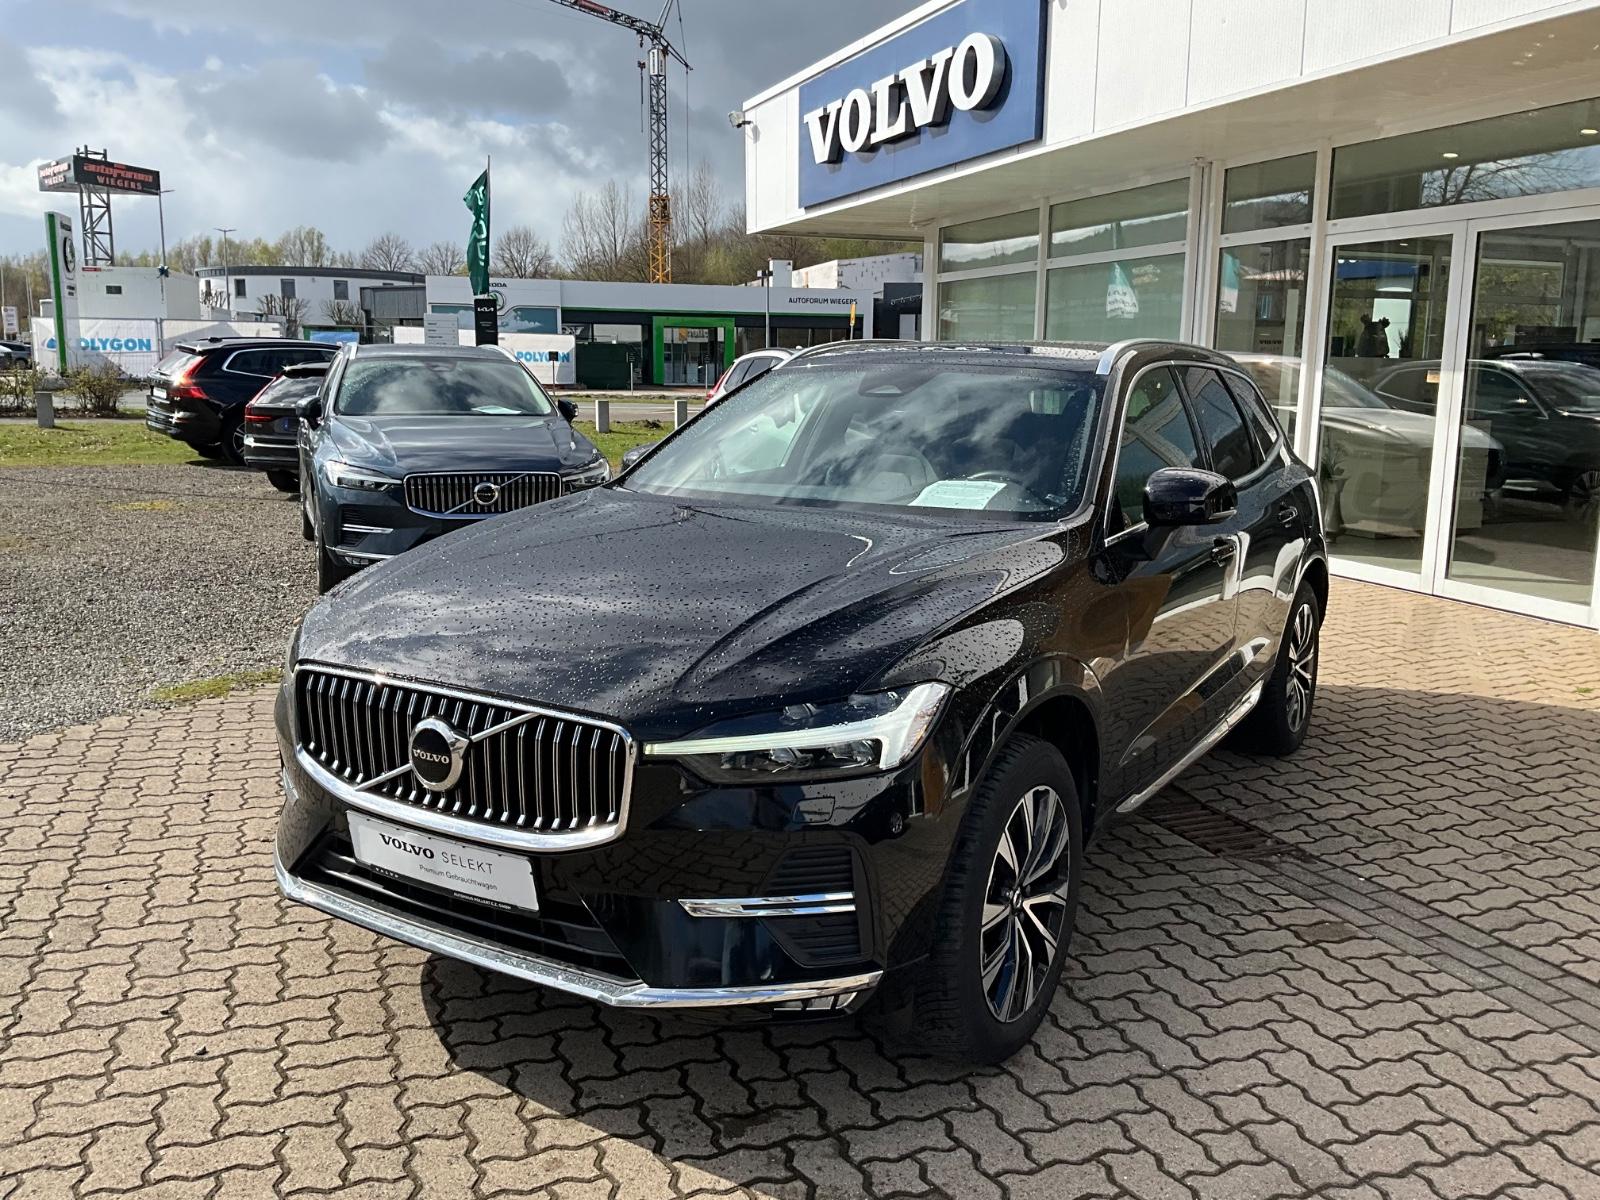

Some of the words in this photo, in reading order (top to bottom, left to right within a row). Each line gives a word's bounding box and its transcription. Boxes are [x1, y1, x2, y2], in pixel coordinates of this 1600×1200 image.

[803, 32, 1004, 164] VOLVO
[96, 175, 142, 190] WIEGERS
[79, 338, 151, 351] OLYGON
[516, 351, 570, 362] POLYN
[412, 749, 450, 764] VOLVO
[379, 833, 435, 859] VOLVO
[441, 851, 493, 875] SELEKT
[419, 864, 445, 877] Premium
[445, 871, 498, 891] Gebrauchtwagen
